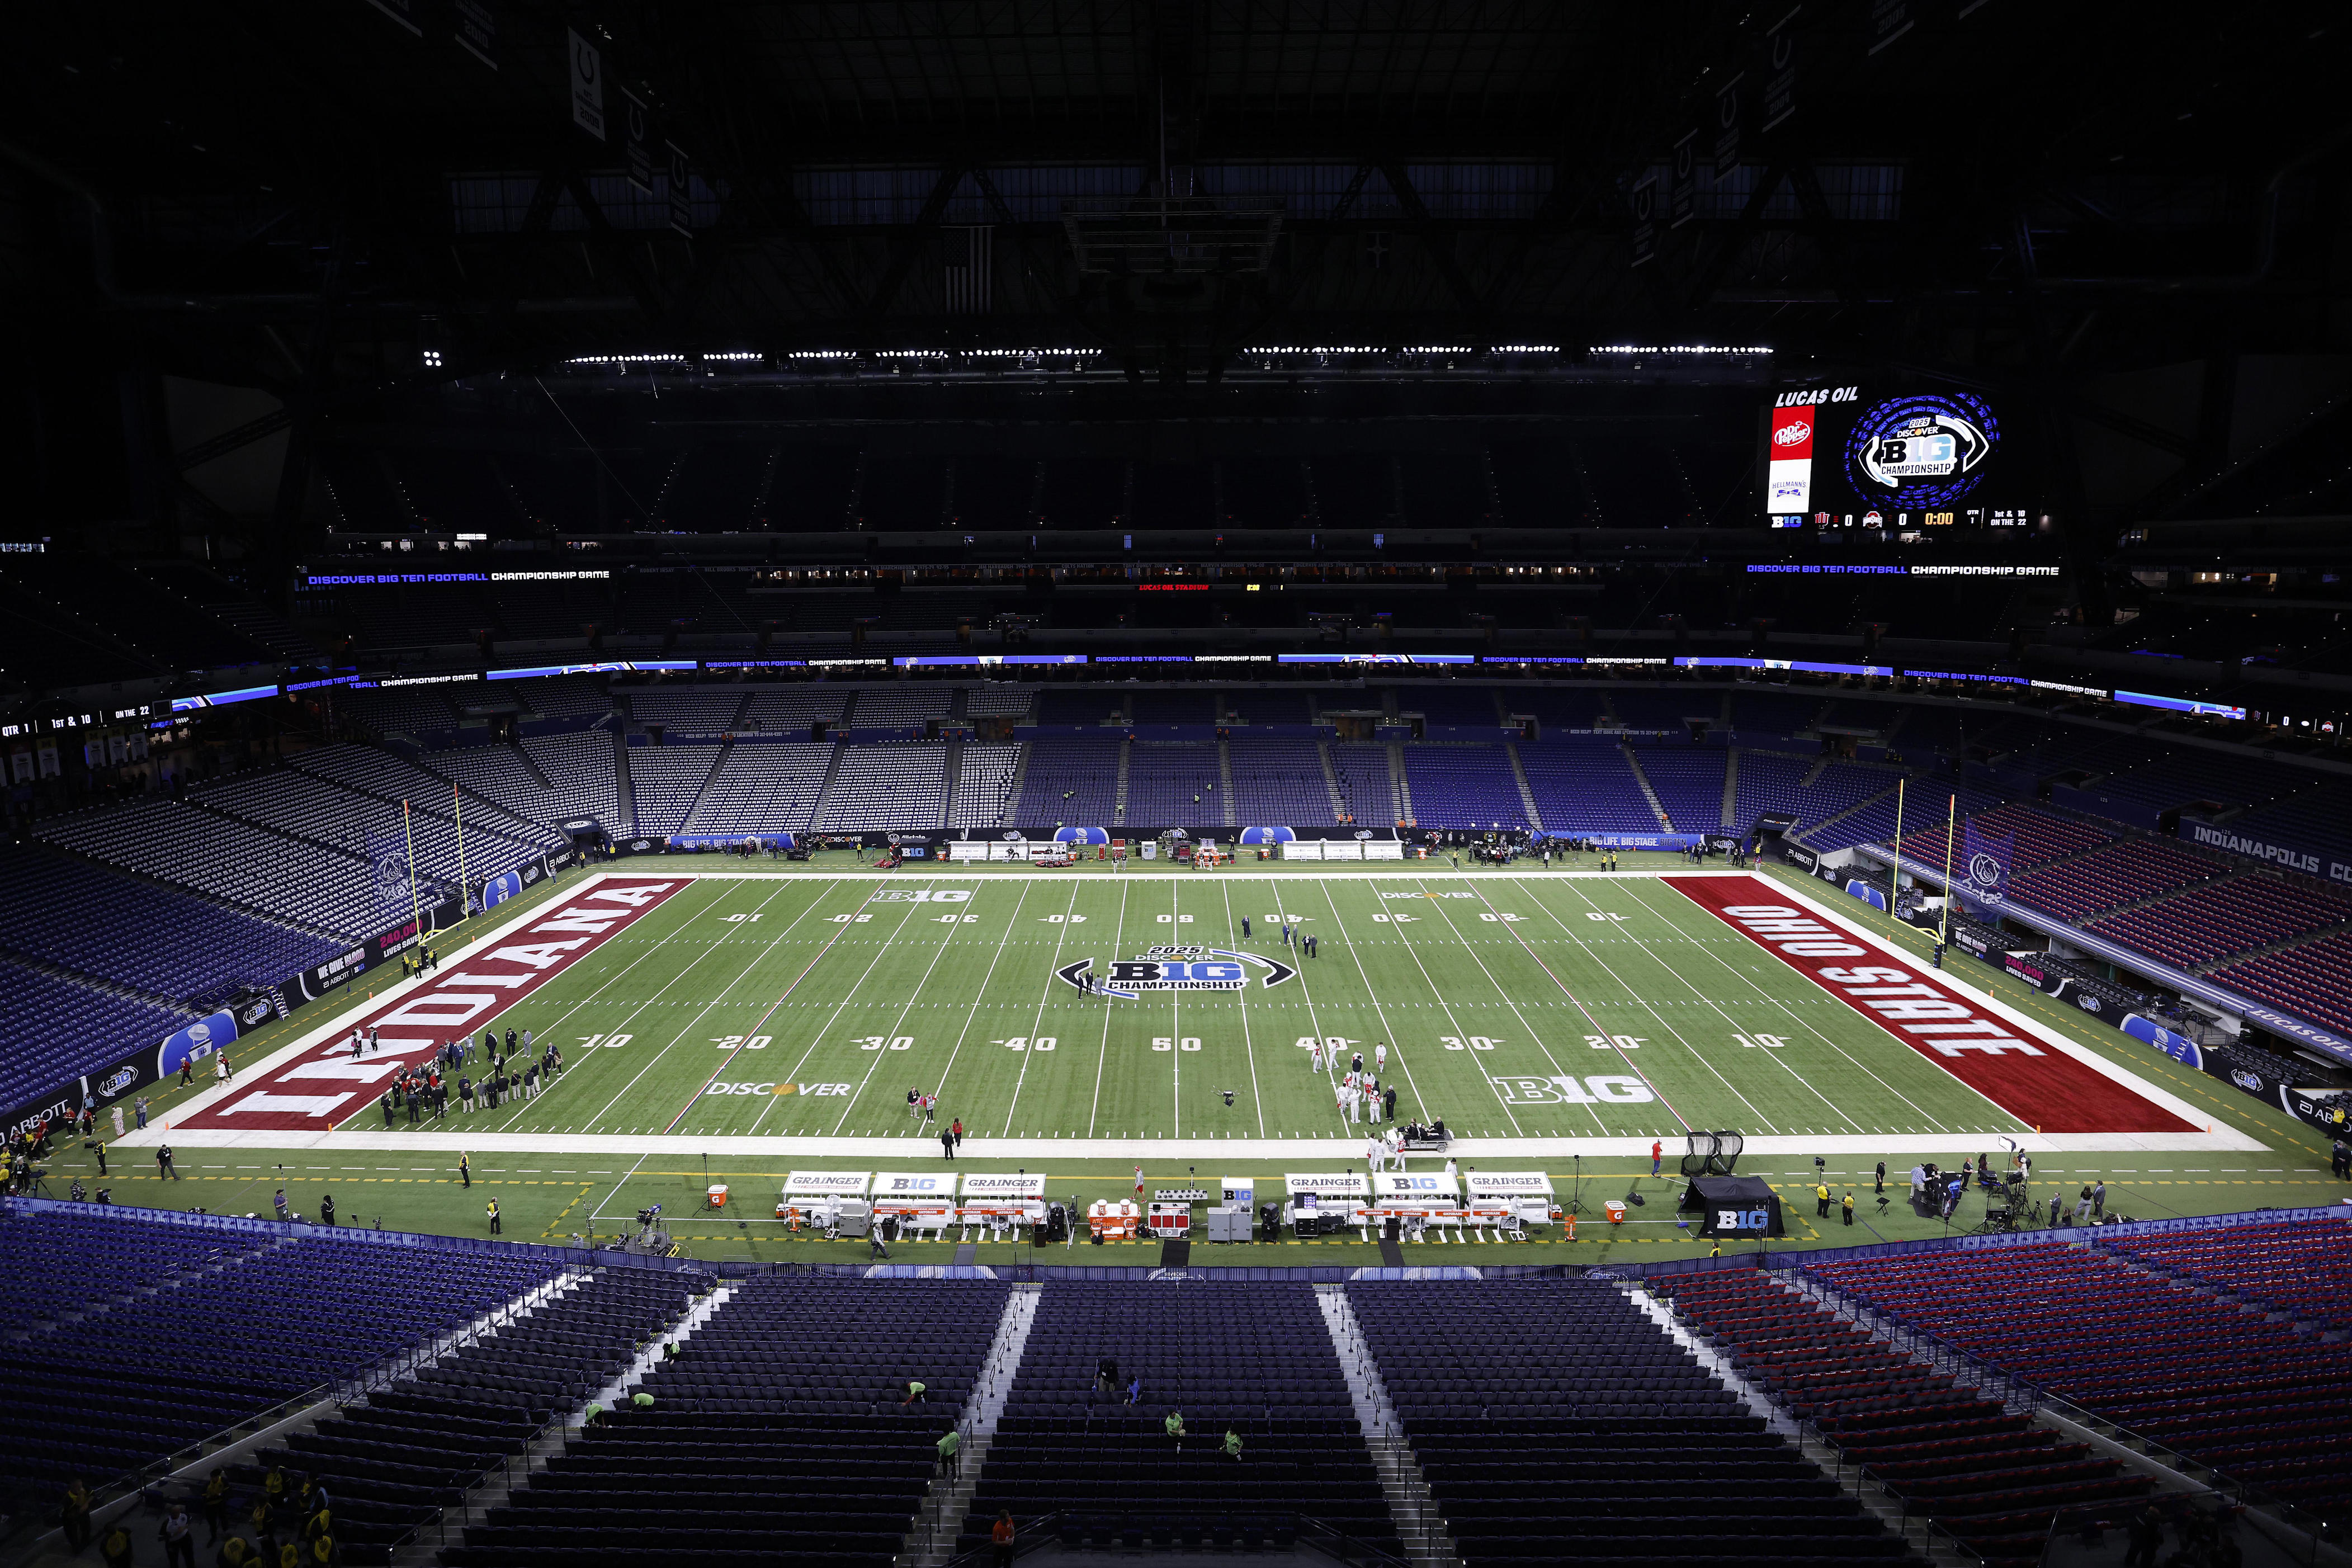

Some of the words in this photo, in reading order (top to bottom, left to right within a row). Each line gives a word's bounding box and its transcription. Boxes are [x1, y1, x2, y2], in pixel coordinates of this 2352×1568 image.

[1775, 389, 1829, 407] LUCAS
[1831, 386, 1859, 402] OIL
[1787, 425, 1800, 434] Dr
[1910, 418, 1929, 427] 2025
[1778, 428, 1807, 445] Pepper
[1897, 427, 1939, 438] DISCOVER
[1882, 464, 1951, 475] CHAMPIONSHIP
[1772, 480, 1807, 489] HELLMANN'S
[1845, 516, 1853, 527] 0
[1898, 513, 1907, 526] 0
[1925, 512, 1954, 525] 0:00
[309, 576, 376, 585] DISCOVER
[377, 575, 398, 583] BIG
[401, 574, 426, 583] TEN
[428, 573, 489, 582] FOOTBALL
[491, 572, 577, 580] CHAMPIONSHIP
[578, 570, 610, 579] GAME
[1911, 566, 2014, 575] CHAMPIONSHIP
[2016, 567, 2060, 575] GAME
[287, 681, 321, 692] DISCOVER
[322, 678, 333, 687] BIG
[333, 676, 346, 684] TEN
[381, 676, 451, 687] CHAMPIONSHIP
[1989, 676, 2030, 685] FOOTBALL
[2031, 679, 2084, 693] CHAMPIONSHIP
[2084, 687, 2108, 697] GAME
[2, 725, 20, 737] QTR
[68, 716, 77, 727] &
[81, 714, 91, 725] 10
[116, 711, 124, 719] ON
[125, 709, 137, 718] THE
[140, 706, 150, 716] 22
[1604, 836, 1621, 847] LIFE.
[1621, 837, 1634, 847] BIG
[1635, 837, 1659, 847] STAGE.
[2194, 826, 2321, 873] INDIANAPOLIS
[1794, 852, 1813, 867] ABBOTT
[1867, 847, 1893, 861] LUCAS
[1904, 862, 1945, 881] STADIUM
[384, 944, 402, 958] LIVES
[402, 933, 423, 949] SAVED
[1955, 930, 1962, 941] WE
[1962, 934, 1972, 946] GIVE
[1972, 938, 1987, 953] BLOOD
[318, 965, 329, 980] WE
[328, 957, 346, 975] GIVE
[343, 947, 366, 967] BLOOD
[2006, 955, 2044, 981] 240,000
[329, 970, 350, 986] ABBOTT
[1721, 905, 1868, 957] OHIO
[1817, 966, 2049, 1057] STATE
[2006, 965, 2022, 978] LIVES
[2022, 974, 2042, 988] SAVED
[1108, 981, 1244, 989] CHAMPIONSHIP
[216, 882, 676, 1118] INDIANA
[2250, 1006, 2311, 1036] LUCAS
[2311, 1033, 2351, 1055] OIL
[580, 1033, 634, 1048] 10
[716, 1035, 773, 1050] 20
[860, 1036, 914, 1051] 30
[1003, 1037, 1057, 1051] 40
[1151, 1037, 1201, 1051] 50
[1295, 1036, 1349, 1051] 40
[1440, 1036, 1495, 1051] 30
[1583, 1035, 1640, 1049] 20
[1731, 1033, 1784, 1047] 10
[706, 1082, 852, 1096] DISCOVER
[10, 1099, 68, 1139] ABBOTT
[792, 1177, 863, 1186] GRAINGER
[711, 1195, 720, 1203] G
[1614, 1211, 1622, 1220] G
